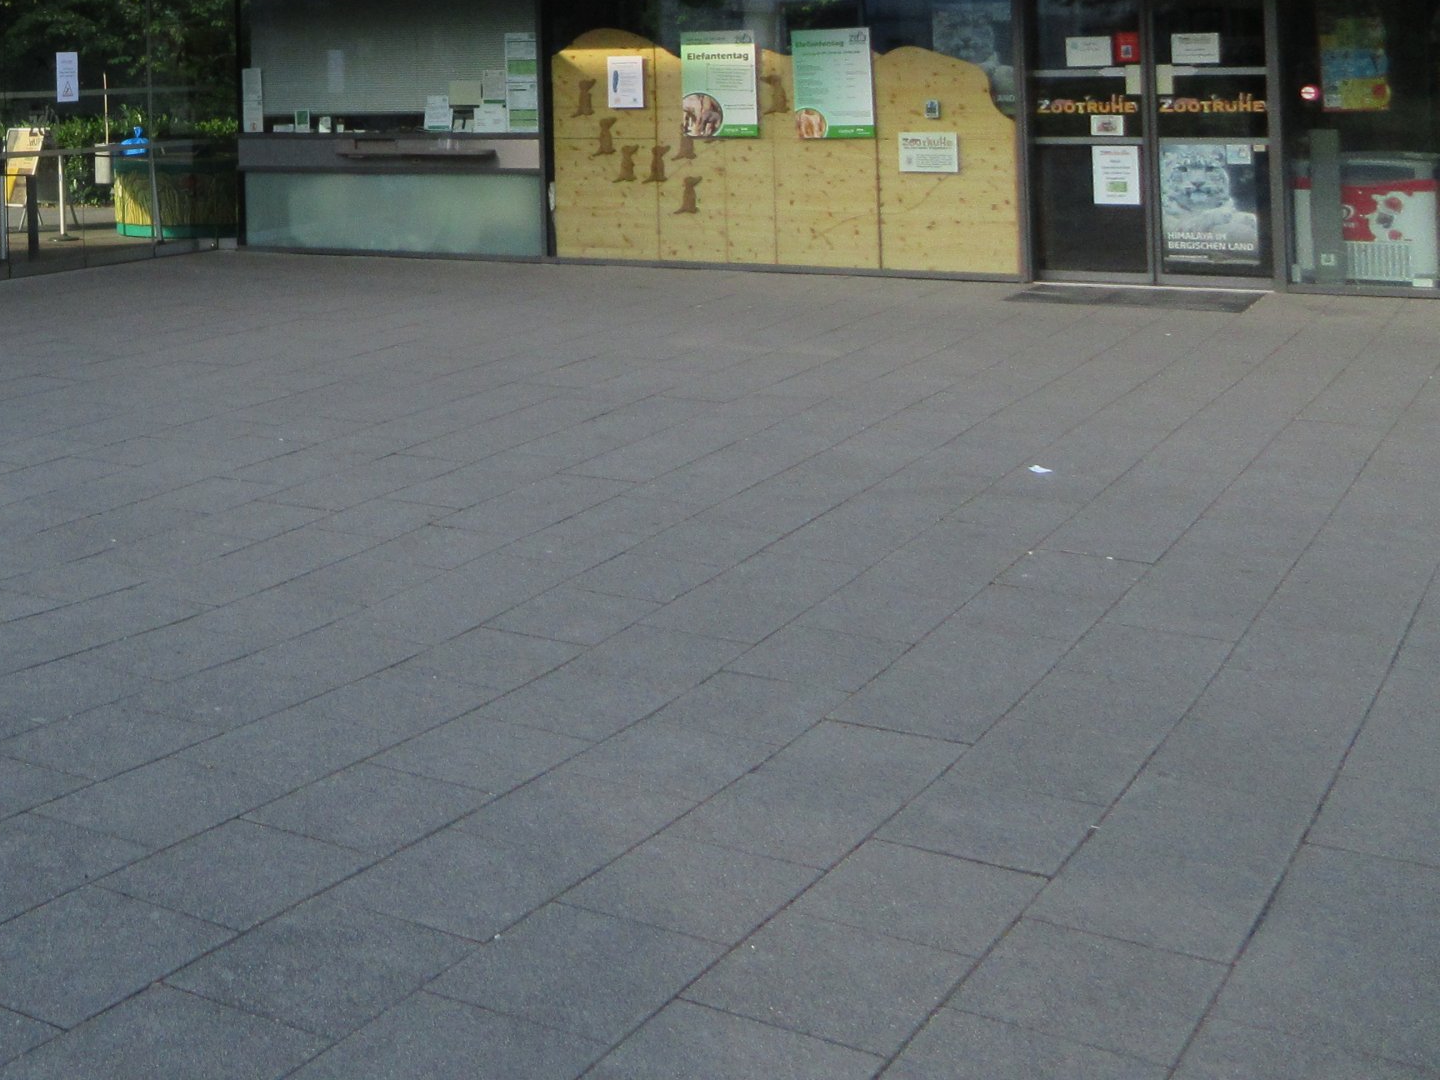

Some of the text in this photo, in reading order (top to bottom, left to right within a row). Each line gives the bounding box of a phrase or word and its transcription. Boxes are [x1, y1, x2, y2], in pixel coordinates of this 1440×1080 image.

[686, 52, 750, 61] Elefantentag
[1167, 231, 1213, 240] HIMALAYA
[1167, 241, 1255, 251] BERGISCHEN LAND
